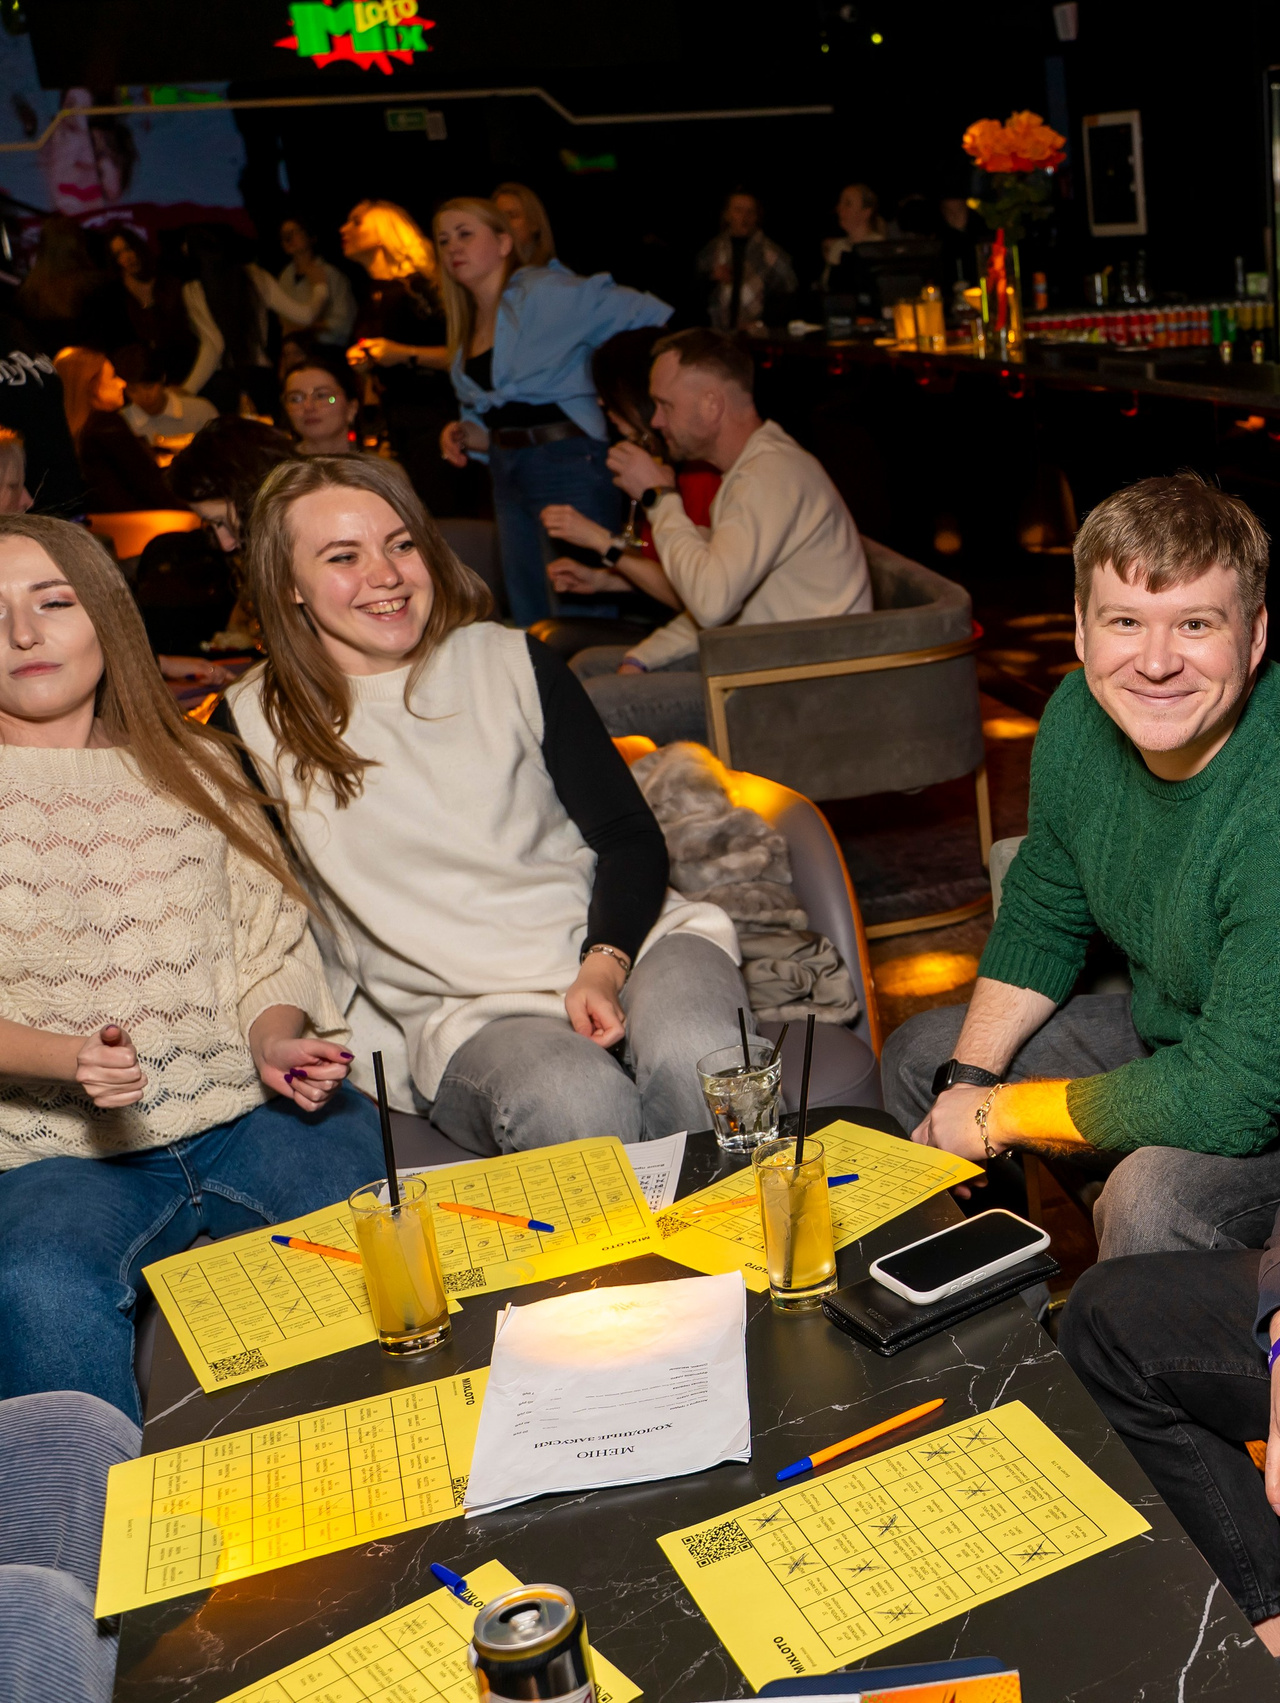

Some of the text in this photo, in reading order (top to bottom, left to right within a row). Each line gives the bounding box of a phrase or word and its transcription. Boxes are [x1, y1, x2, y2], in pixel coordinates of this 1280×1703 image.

[602, 1235, 650, 1252] MIXLOTO
[744, 1262, 769, 1274] LOTO
[461, 1378, 475, 1406] MIXLOTO
[533, 1422, 673, 1449] ХОЛОДНЫЕ ЗАКУСКИ
[576, 1445, 635, 1459] МЕНЮ
[772, 1635, 806, 1674] MIXLOTO
